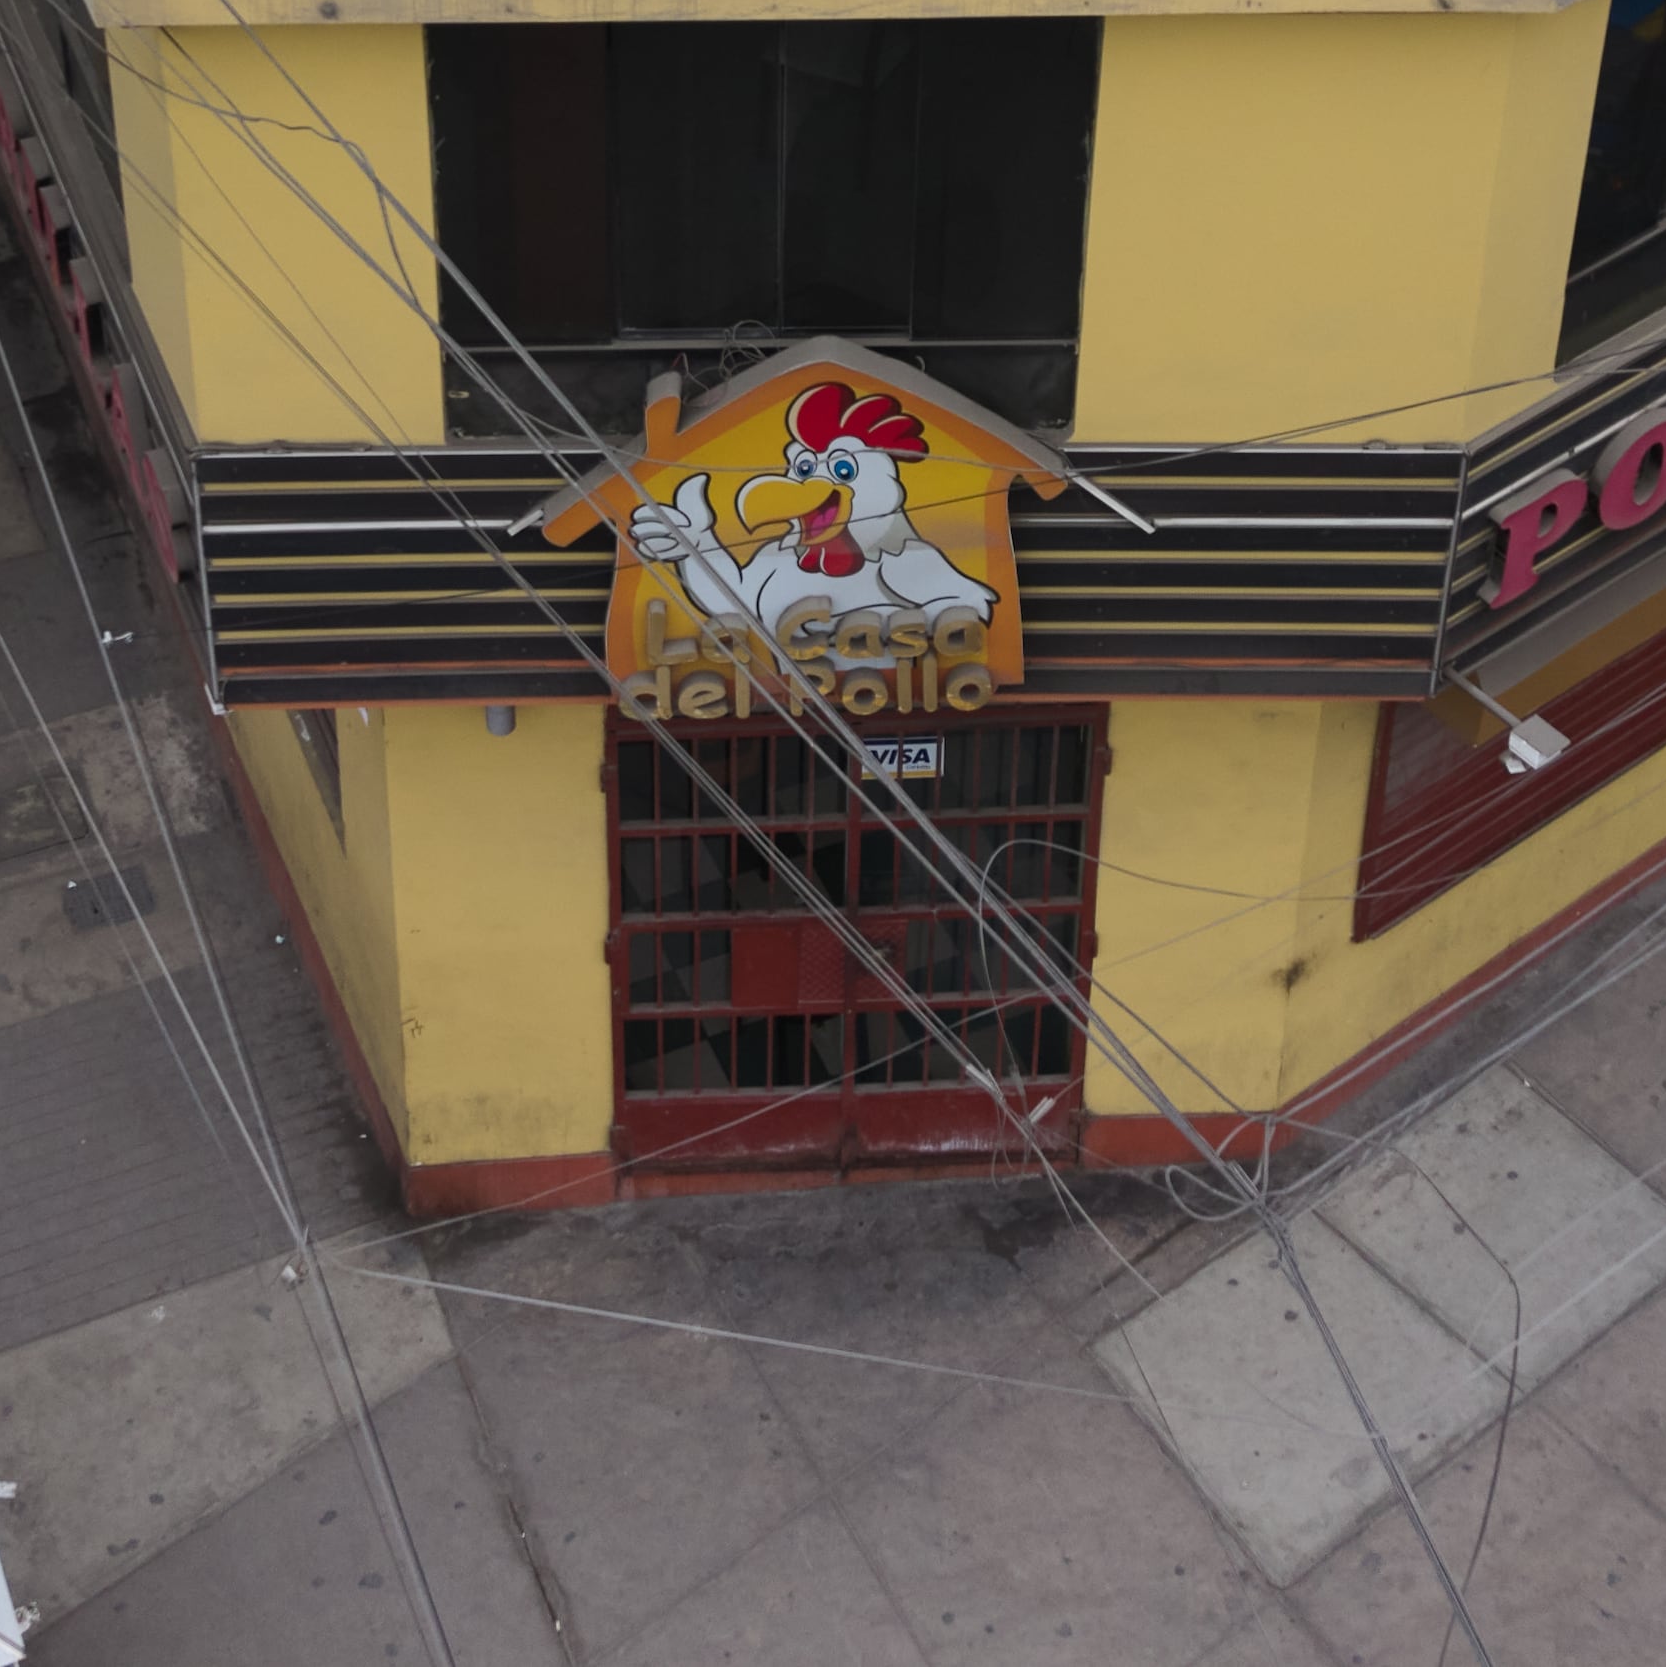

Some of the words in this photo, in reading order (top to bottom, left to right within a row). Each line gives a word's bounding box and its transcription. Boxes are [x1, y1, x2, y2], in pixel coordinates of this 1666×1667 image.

[648, 599, 751, 665] La
[775, 595, 987, 661] Casa
[619, 664, 751, 721] del
[790, 657, 993, 718] Pollo
[871, 748, 931, 765] VISA
